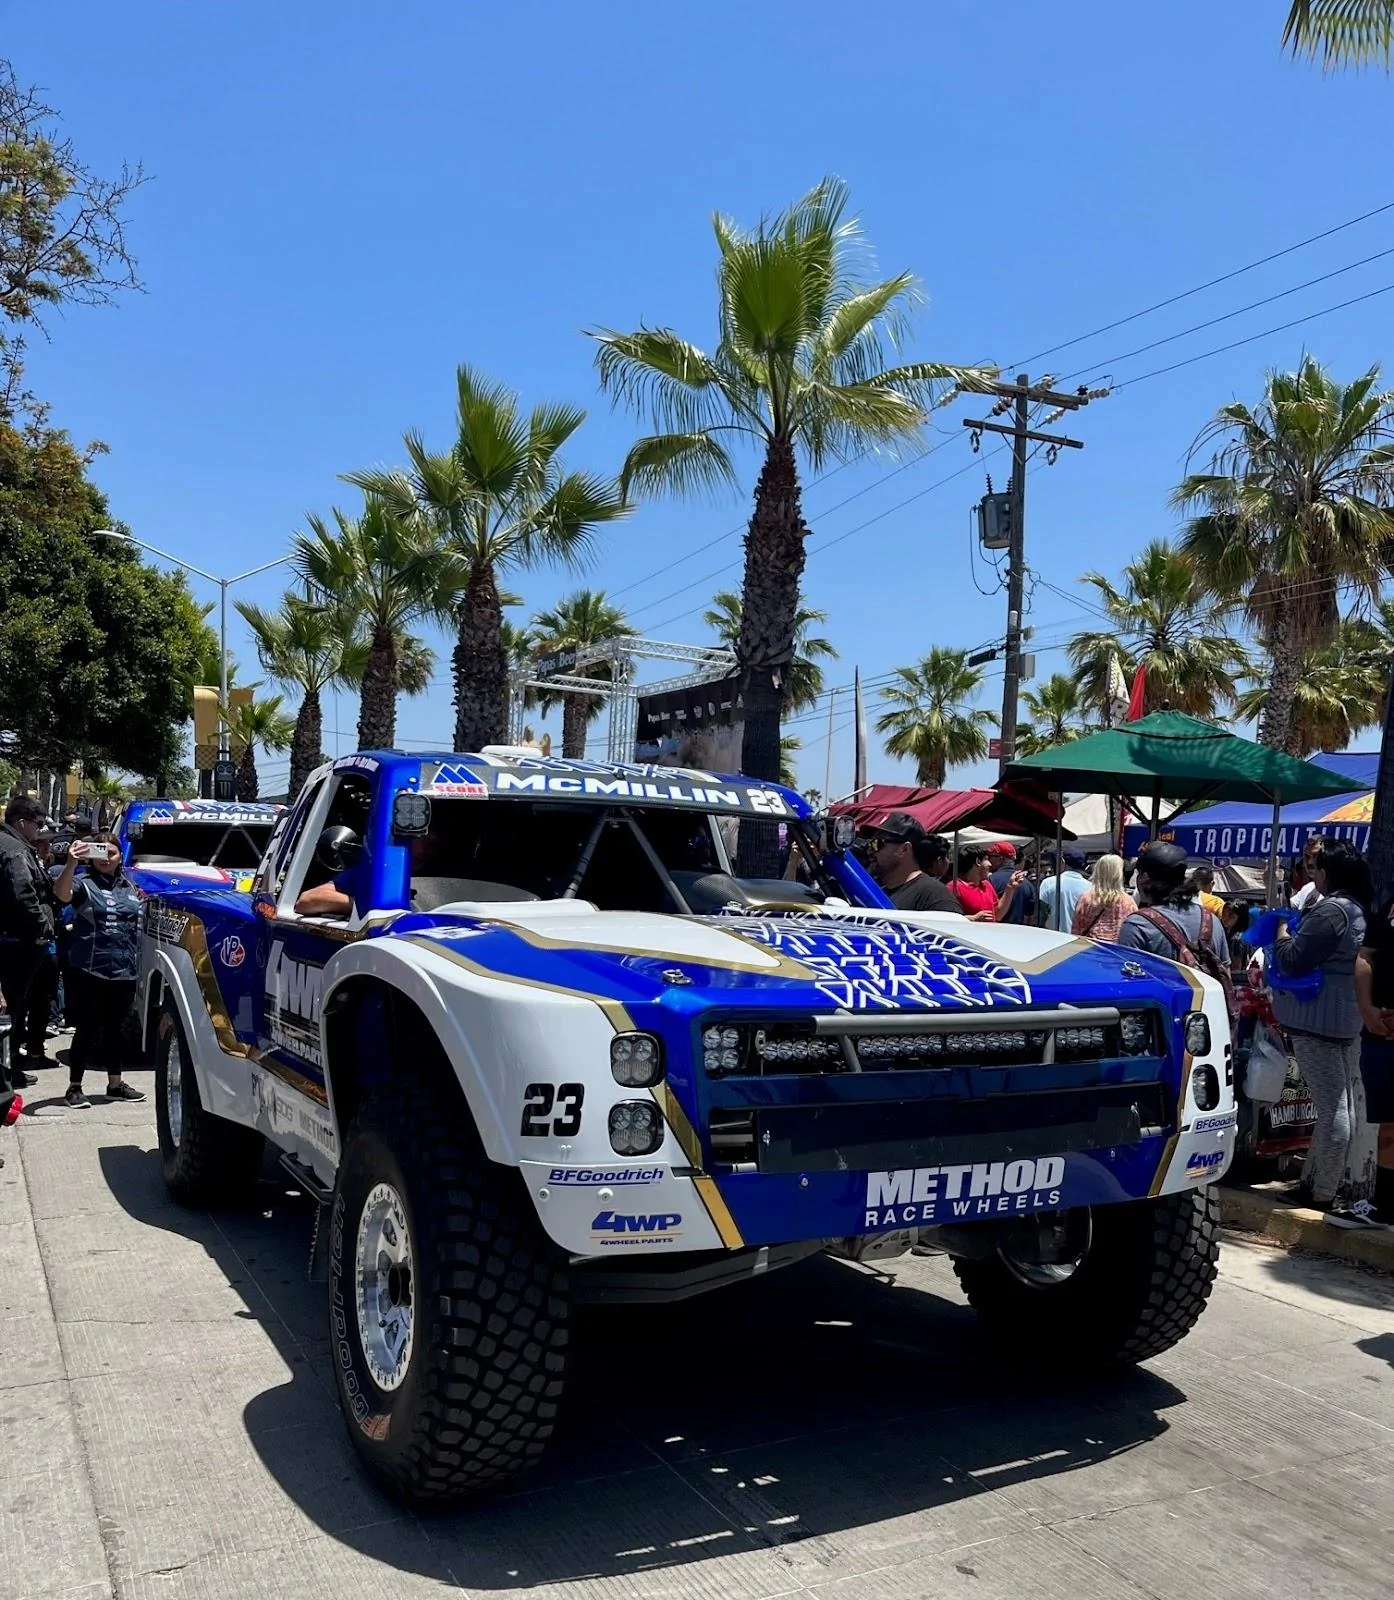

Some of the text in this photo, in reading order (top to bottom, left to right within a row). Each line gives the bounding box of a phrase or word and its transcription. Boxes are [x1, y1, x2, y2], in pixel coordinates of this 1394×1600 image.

[435, 785, 486, 793] SCORE
[746, 788, 787, 815] 23
[520, 1083, 585, 1138] 23
[1187, 1151, 1225, 1169] 4WP
[549, 1168, 664, 1182] BFGoodrich
[866, 1156, 1066, 1208] METHOD
[865, 1190, 1061, 1227] RACE WHEELS
[592, 1211, 682, 1233] 4WP
